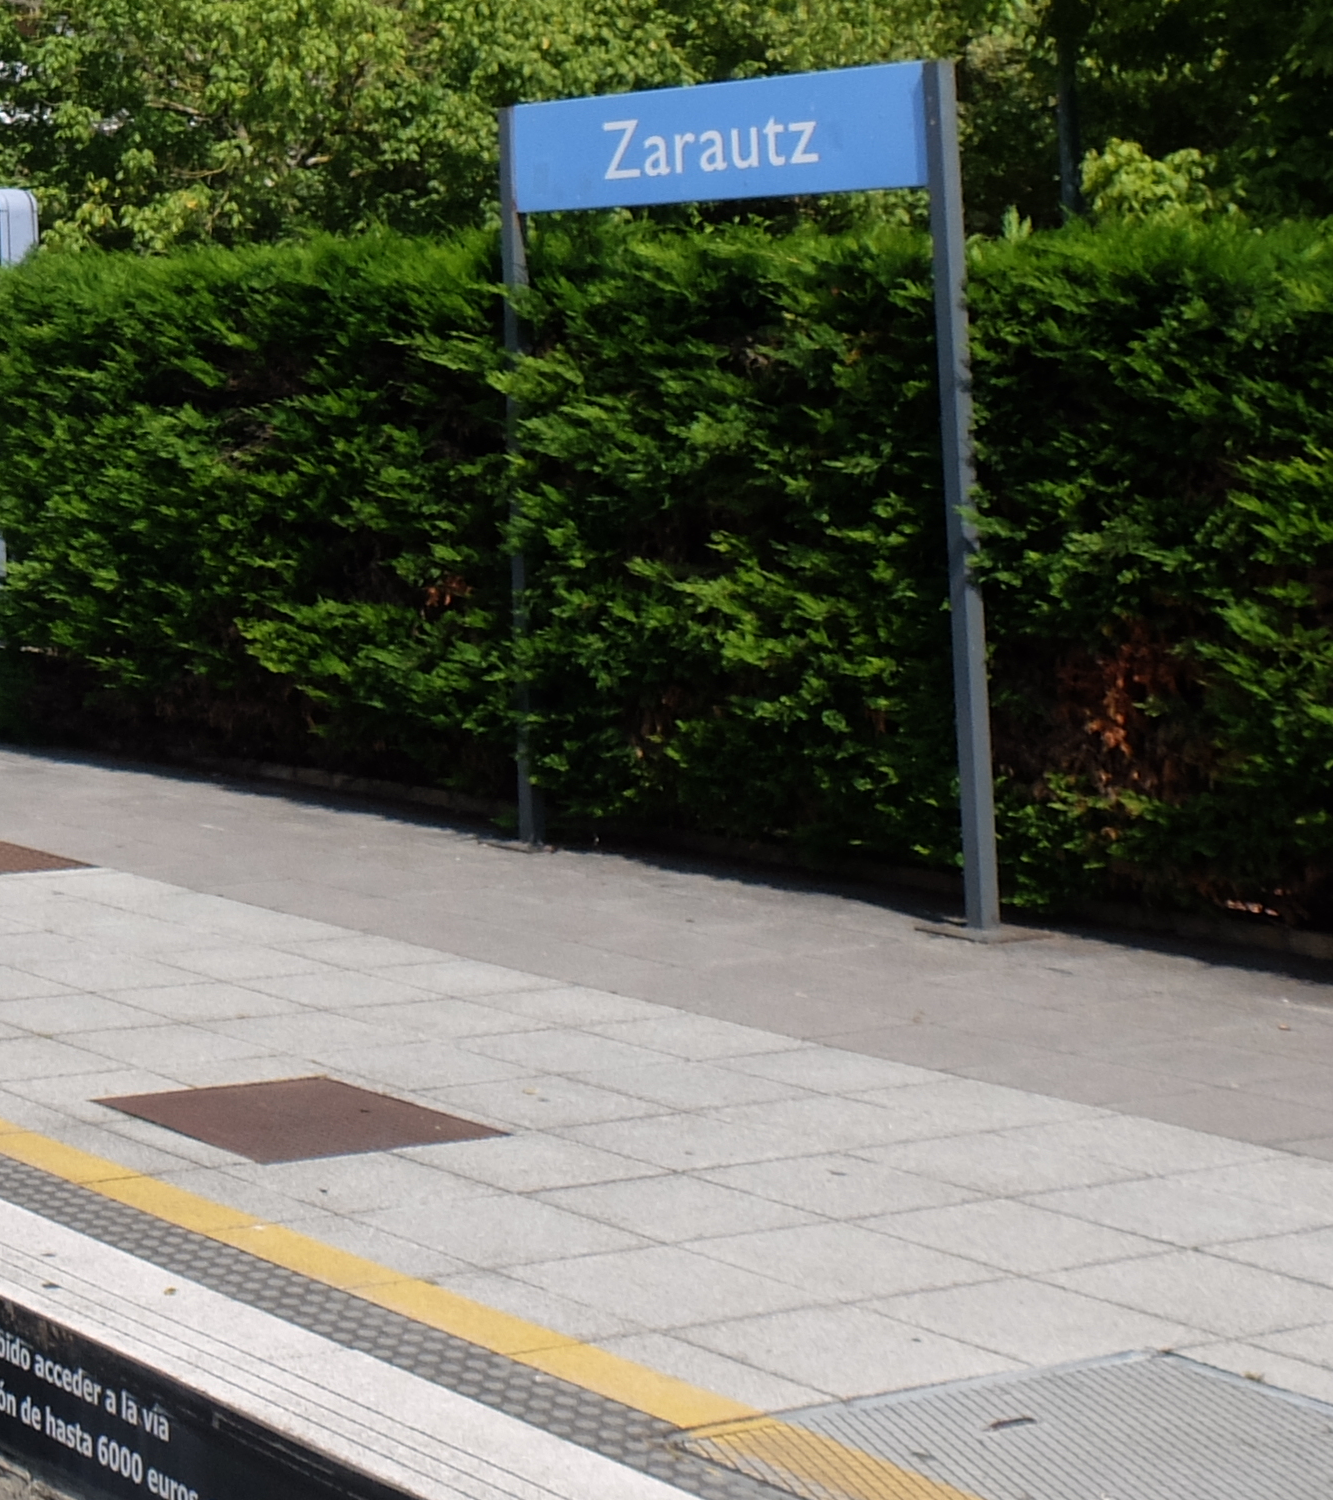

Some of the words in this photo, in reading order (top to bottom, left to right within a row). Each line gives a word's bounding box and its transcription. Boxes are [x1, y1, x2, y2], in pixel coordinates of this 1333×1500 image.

[602, 116, 819, 180] Zarautz
[35, 1352, 102, 1404] acceder
[106, 1392, 117, 1417] a
[121, 1389, 137, 1426] la
[21, 1395, 41, 1432] de
[45, 1405, 93, 1458] hasta
[97, 1434, 143, 1485] 6000
